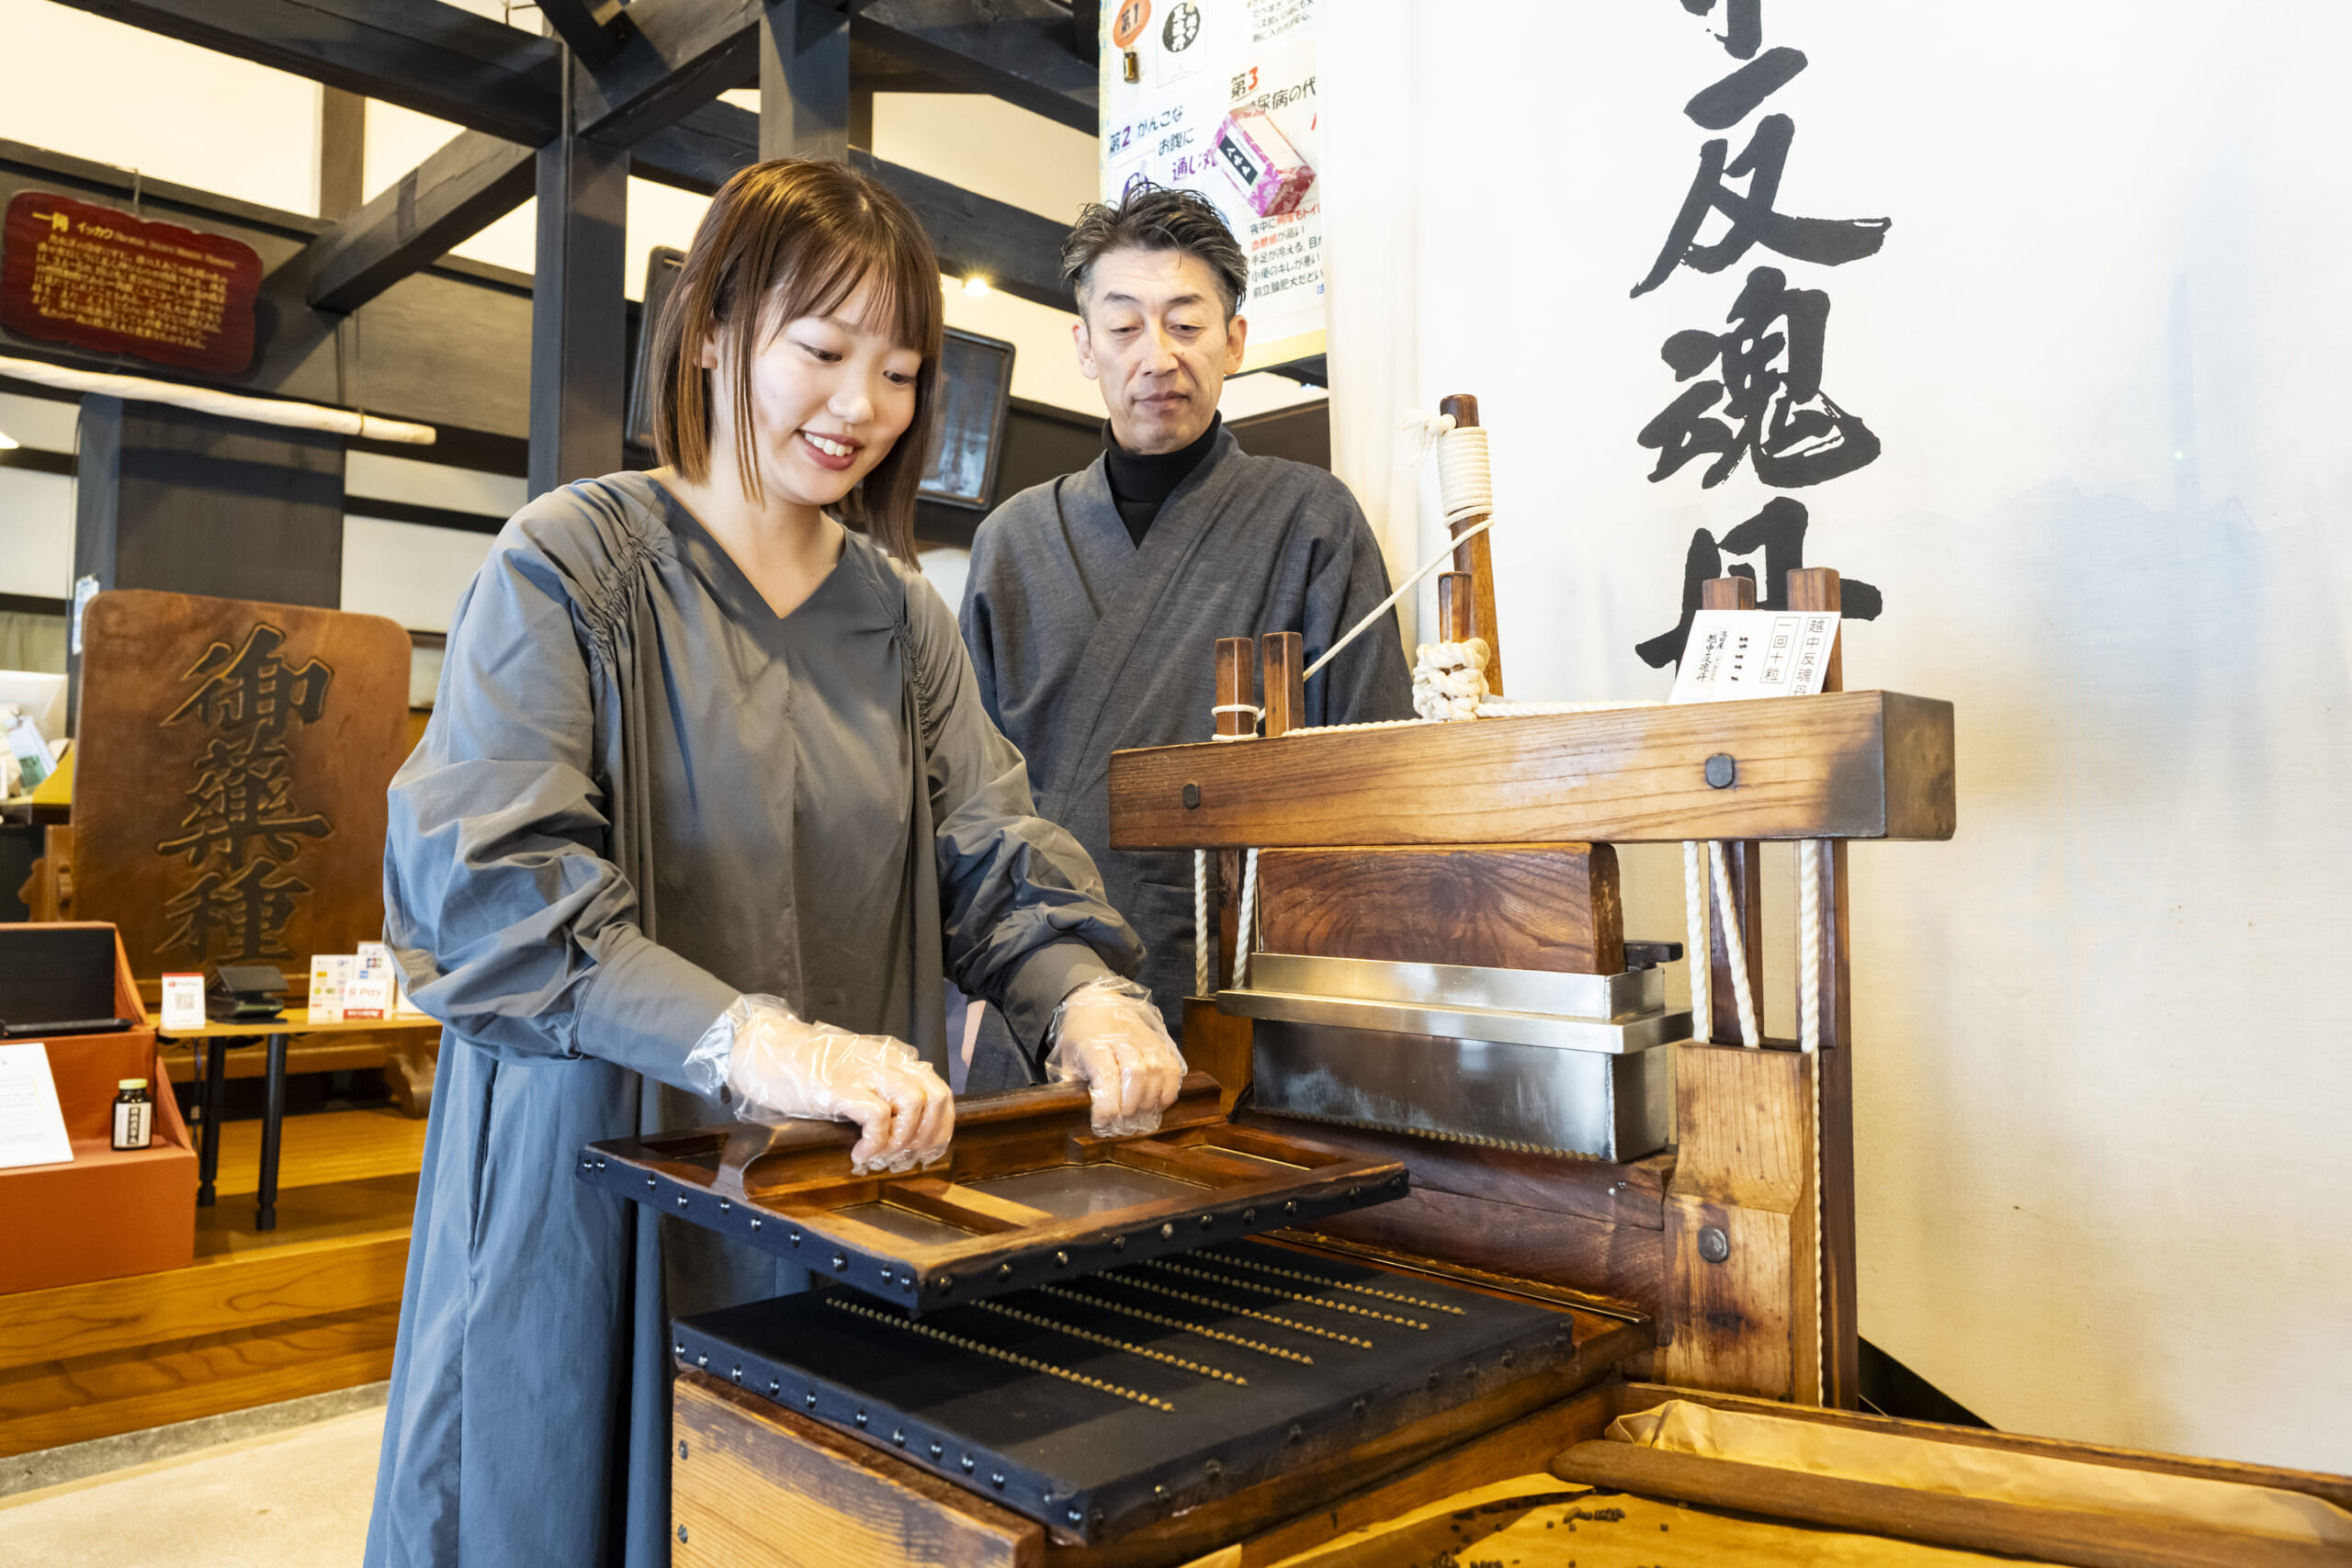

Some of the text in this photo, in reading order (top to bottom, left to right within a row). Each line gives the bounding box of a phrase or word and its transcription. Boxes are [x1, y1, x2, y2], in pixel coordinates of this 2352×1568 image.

[1230, 66, 1259, 99] 第3
[1250, 76, 1317, 113] 尿病の代
[1109, 106, 1183, 155] 第2 がんこな
[1158, 128, 1195, 156] お腹に
[1630, 0, 1892, 669] 反魂丹
[1764, 624, 1792, 682] 一回十粒
[1793, 619, 1826, 695] 越中反魂丹
